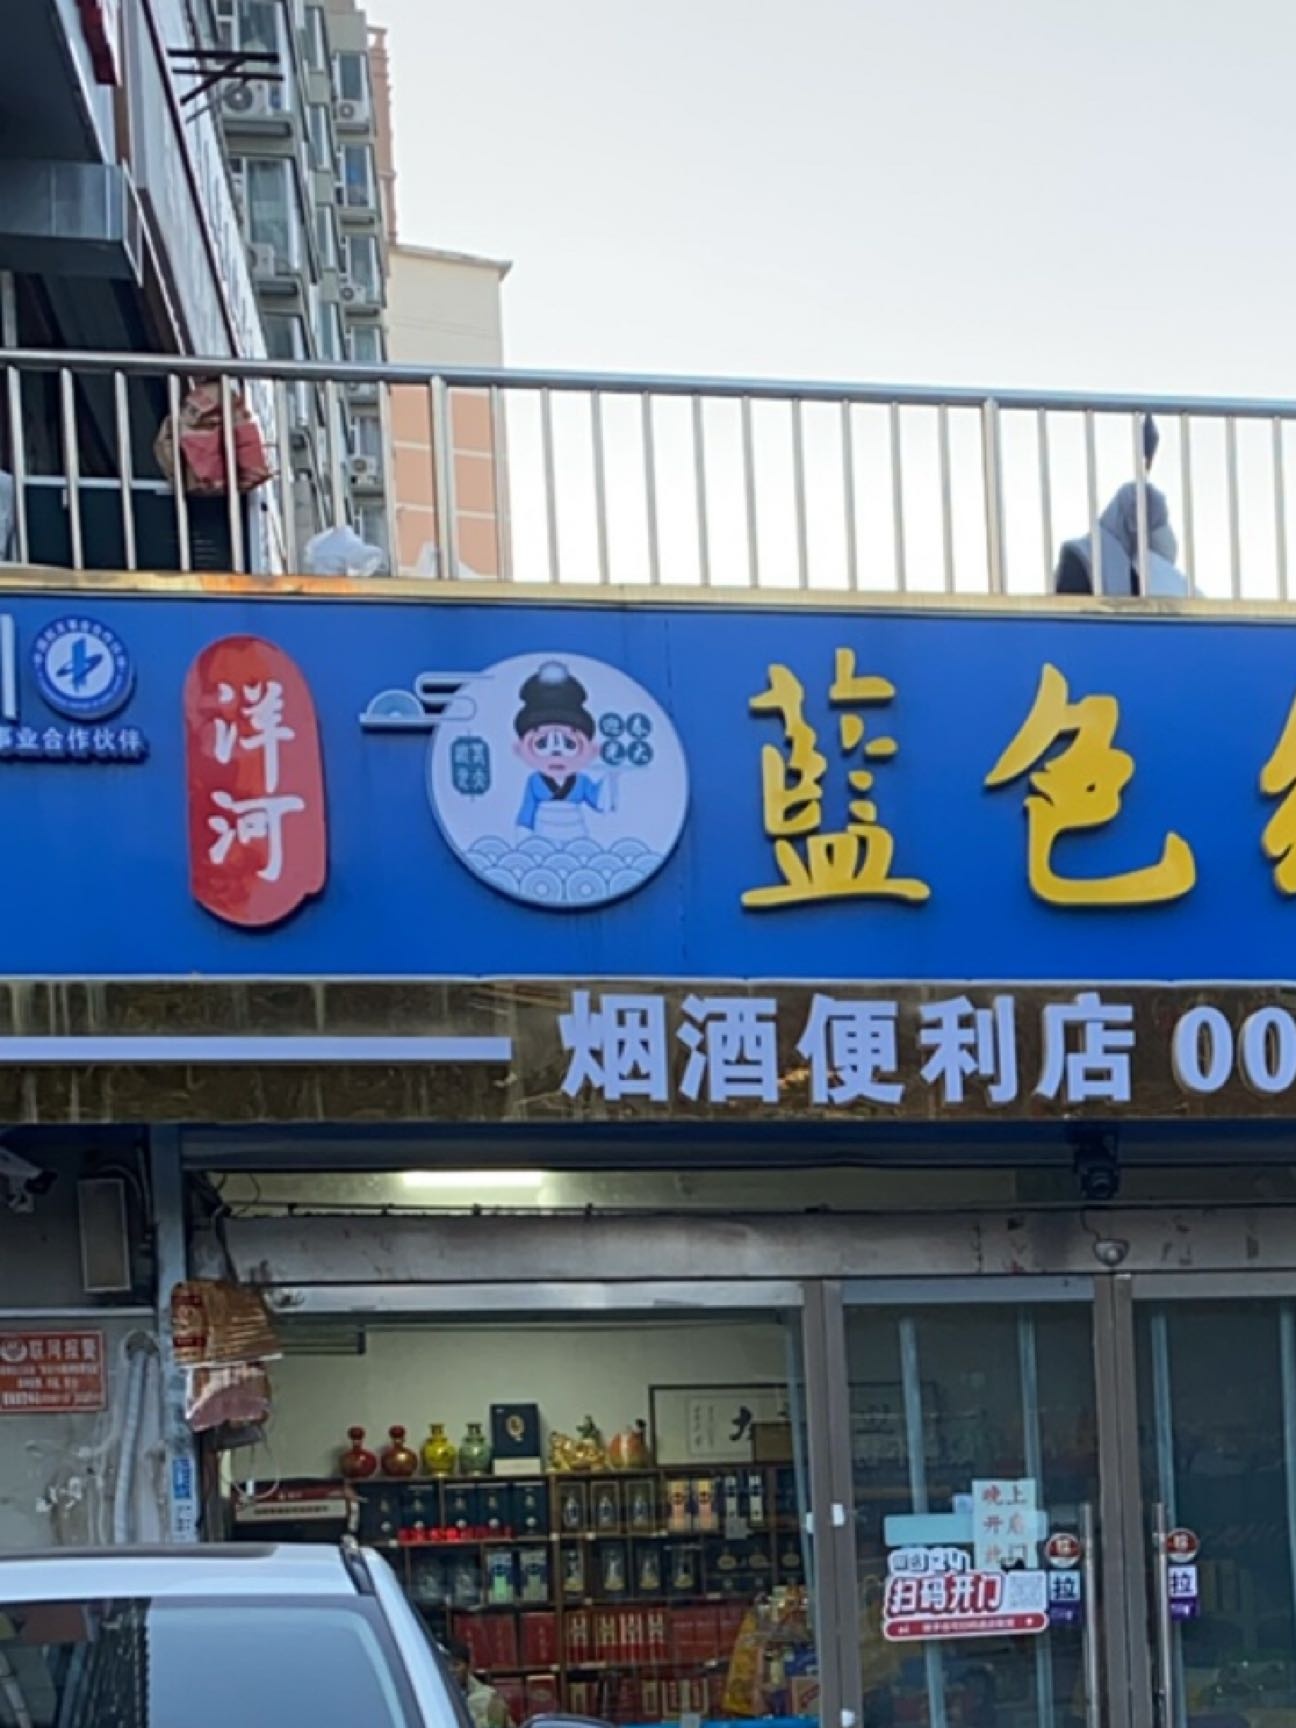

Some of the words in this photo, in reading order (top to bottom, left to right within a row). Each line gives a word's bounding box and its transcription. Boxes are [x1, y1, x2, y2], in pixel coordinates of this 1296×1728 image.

[208, 681, 305, 881] 洋河
[558, 990, 1137, 1106] 烟酒便利店
[890, 1575, 1002, 1616] 扫码开门
[1052, 1576, 1077, 1600] 拉
[1170, 1570, 1194, 1596] 拉
